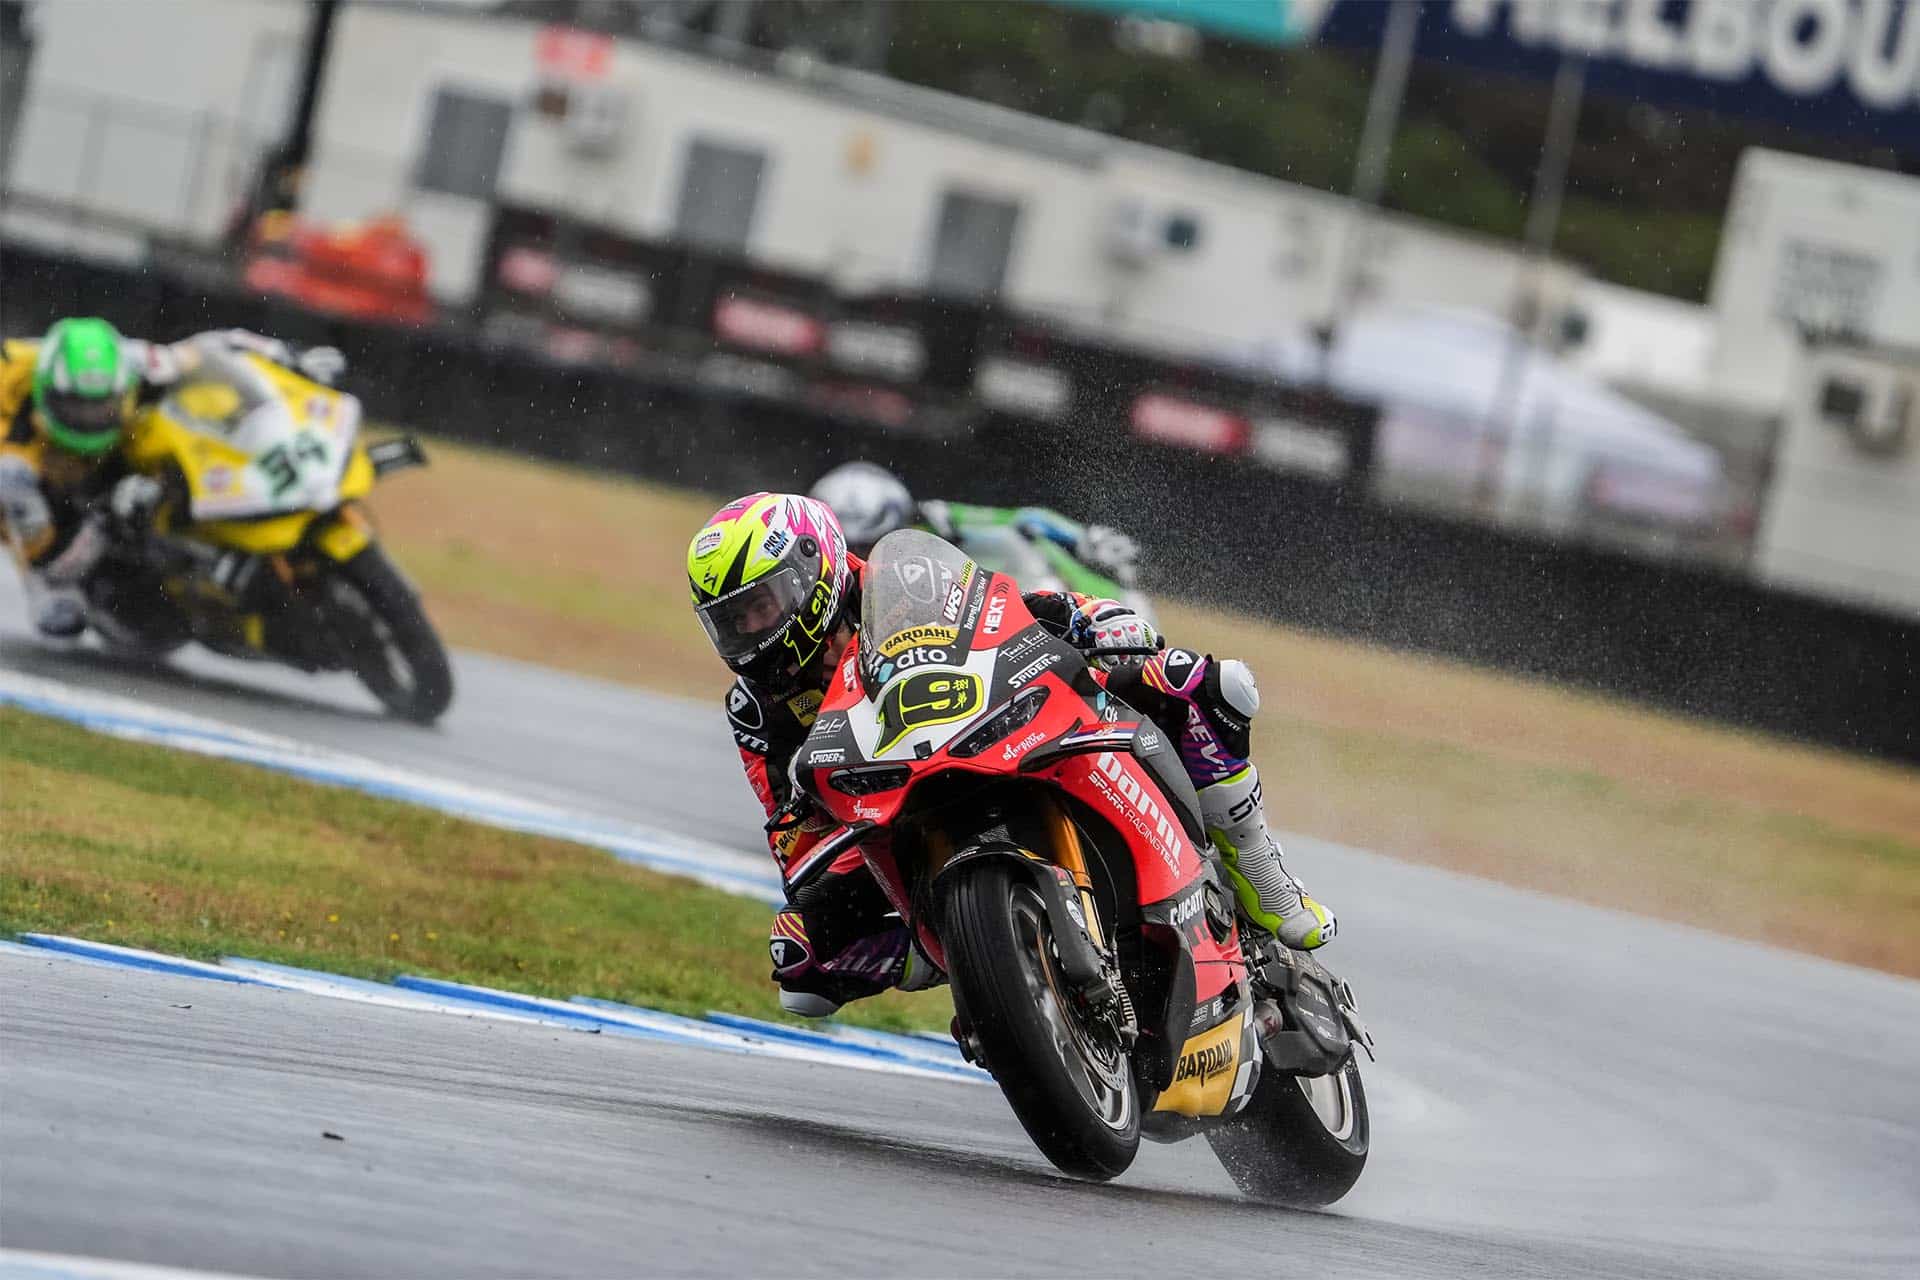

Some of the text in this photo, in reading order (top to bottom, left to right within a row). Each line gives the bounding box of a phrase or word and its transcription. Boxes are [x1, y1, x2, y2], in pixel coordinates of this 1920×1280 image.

[758, 613, 798, 651] Motostorm.it
[983, 596, 1007, 634] NEXT
[884, 628, 956, 651] BARDAHL
[896, 647, 948, 669] dto
[1008, 653, 1052, 689] SPIDER
[807, 748, 845, 765] SPIDER
[1087, 770, 1129, 816] SPARK
[1175, 1038, 1234, 1088] BARDAHL
